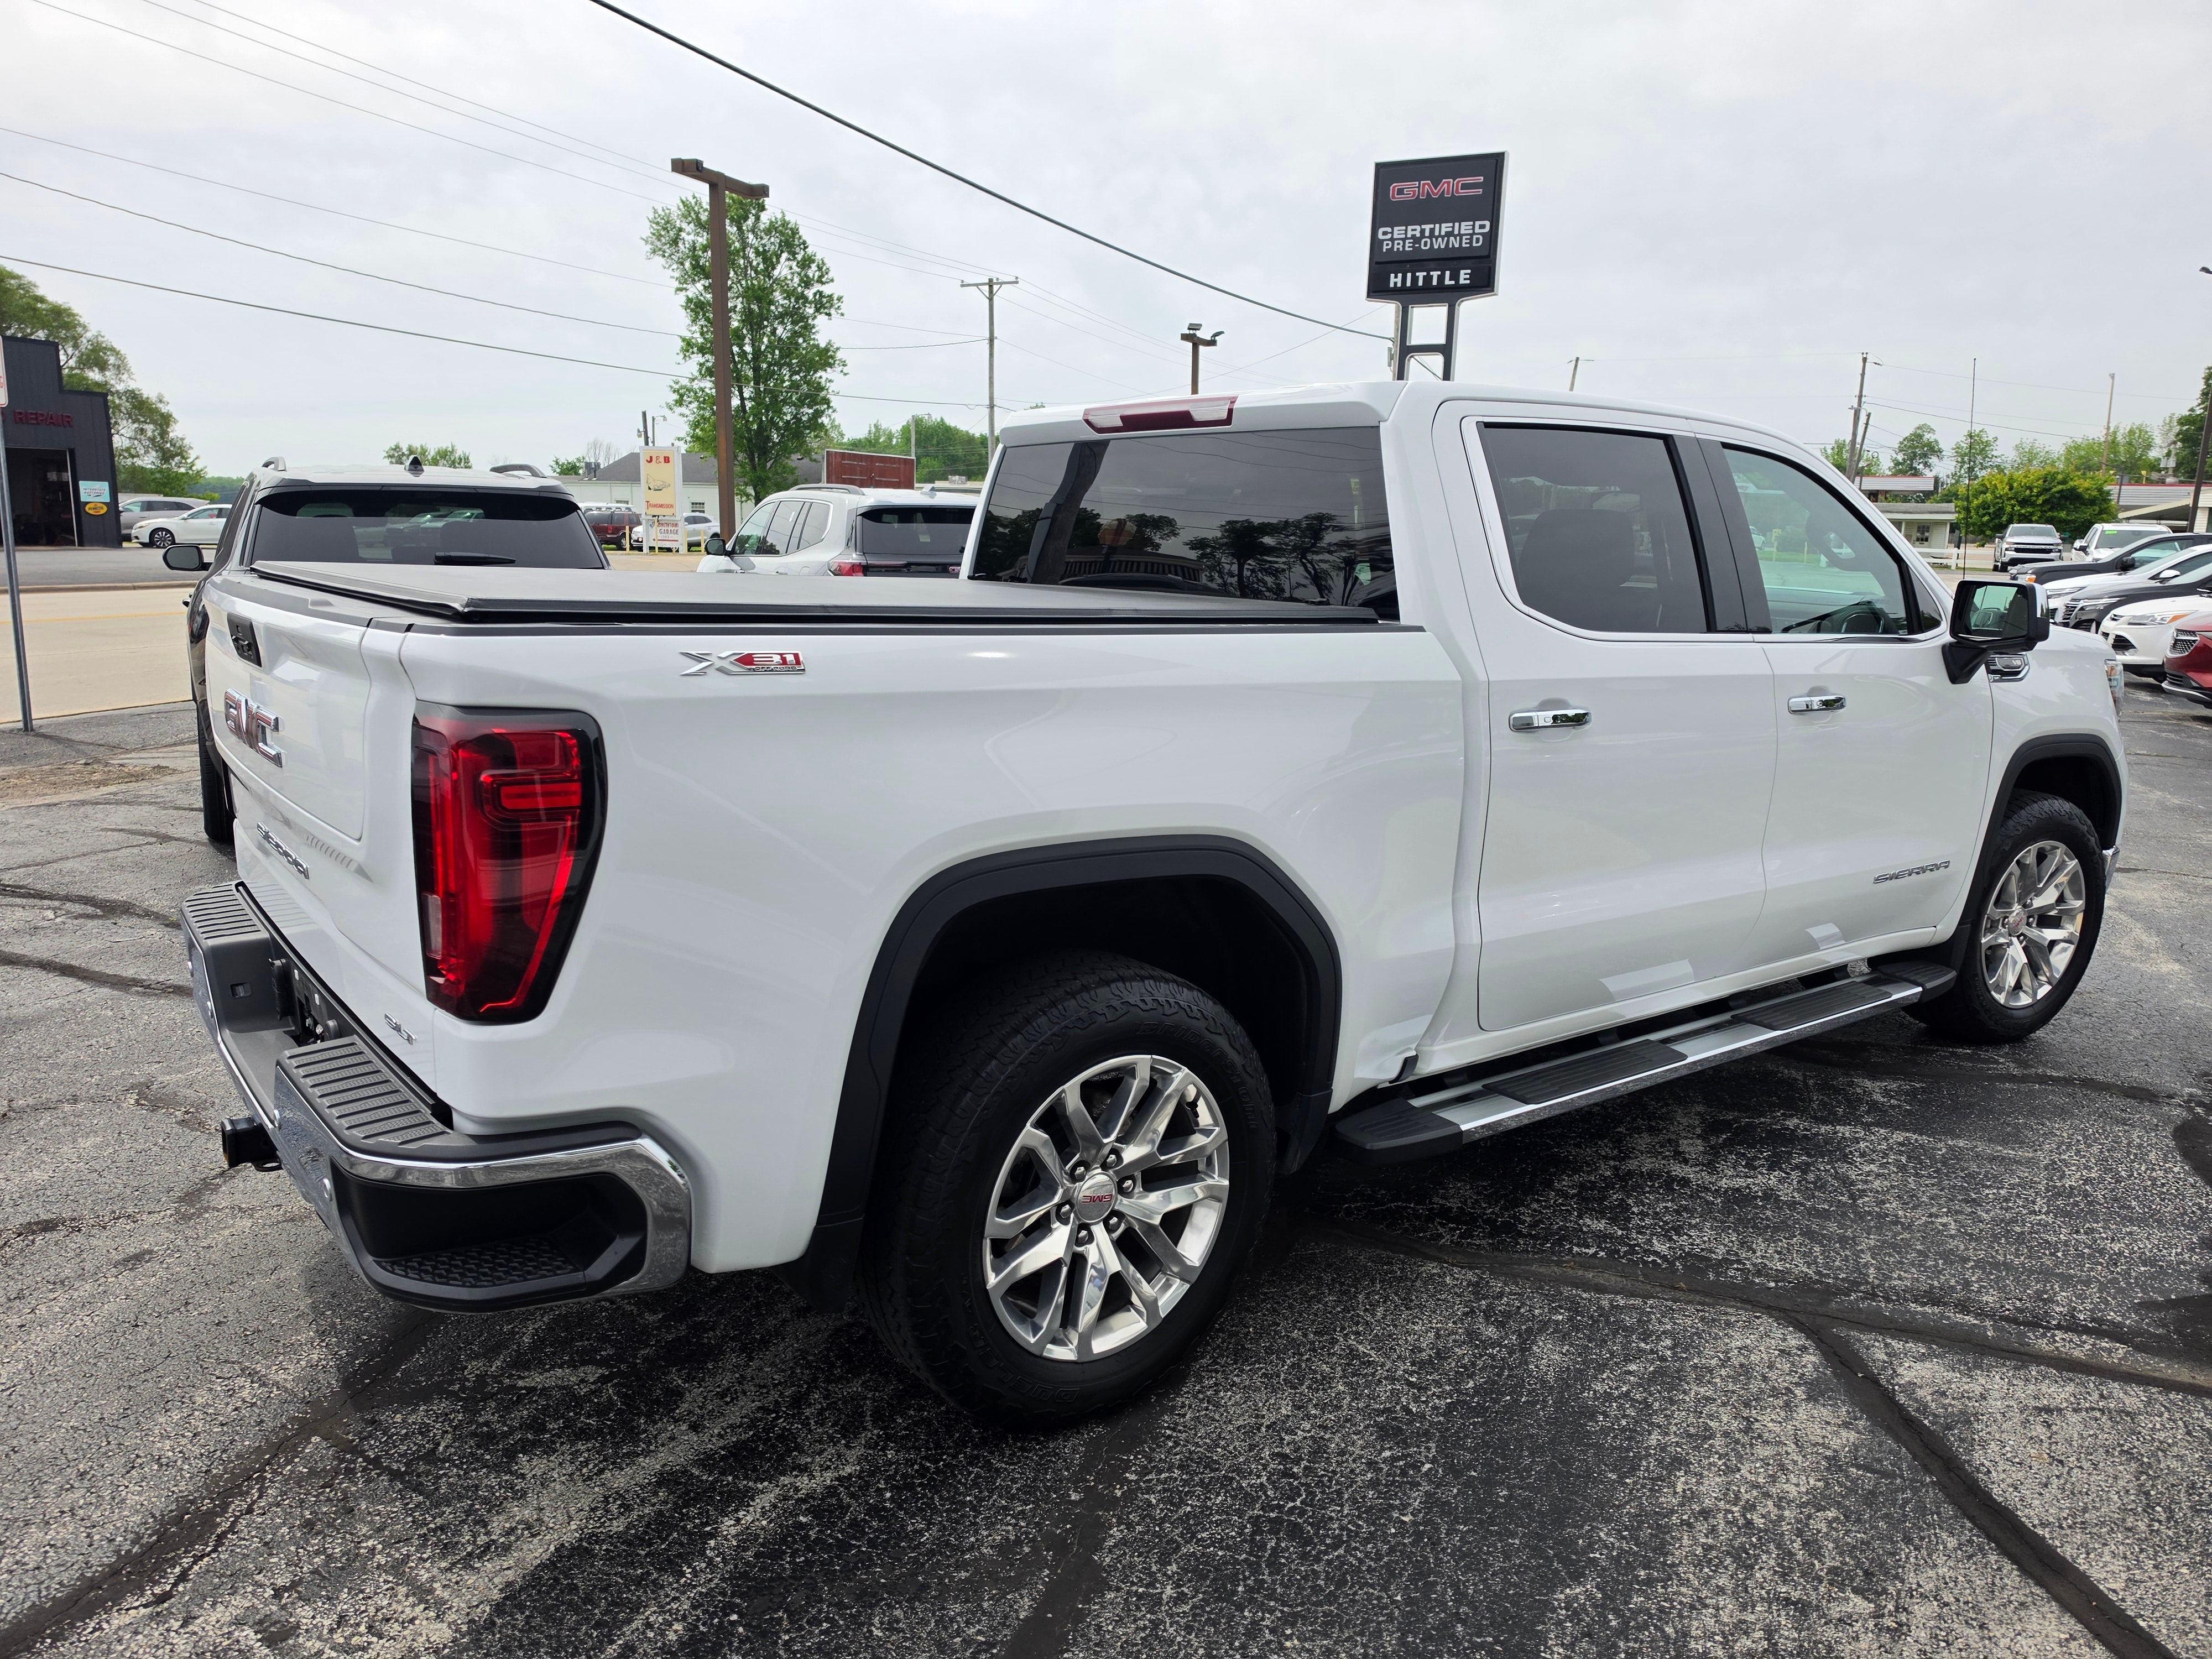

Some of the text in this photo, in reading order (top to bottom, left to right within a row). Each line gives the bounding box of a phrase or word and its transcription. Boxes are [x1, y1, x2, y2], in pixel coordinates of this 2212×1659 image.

[1390, 176, 1484, 201] GMC
[1378, 220, 1490, 239] CERTIFIED
[1383, 234, 1483, 252] PRE-OWNED
[1389, 269, 1472, 288] HITTLE
[14, 410, 74, 427] REPAIR
[655, 456, 662, 464] &
[645, 500, 674, 510] TRANSMISSION
[224, 688, 283, 768] GMC
[1874, 859, 1950, 884] SIERRA
[384, 1013, 416, 1045] SLT
[1136, 1021, 1260, 1133] BRIDGESTONE
[1081, 1193, 1113, 1204] GMC
